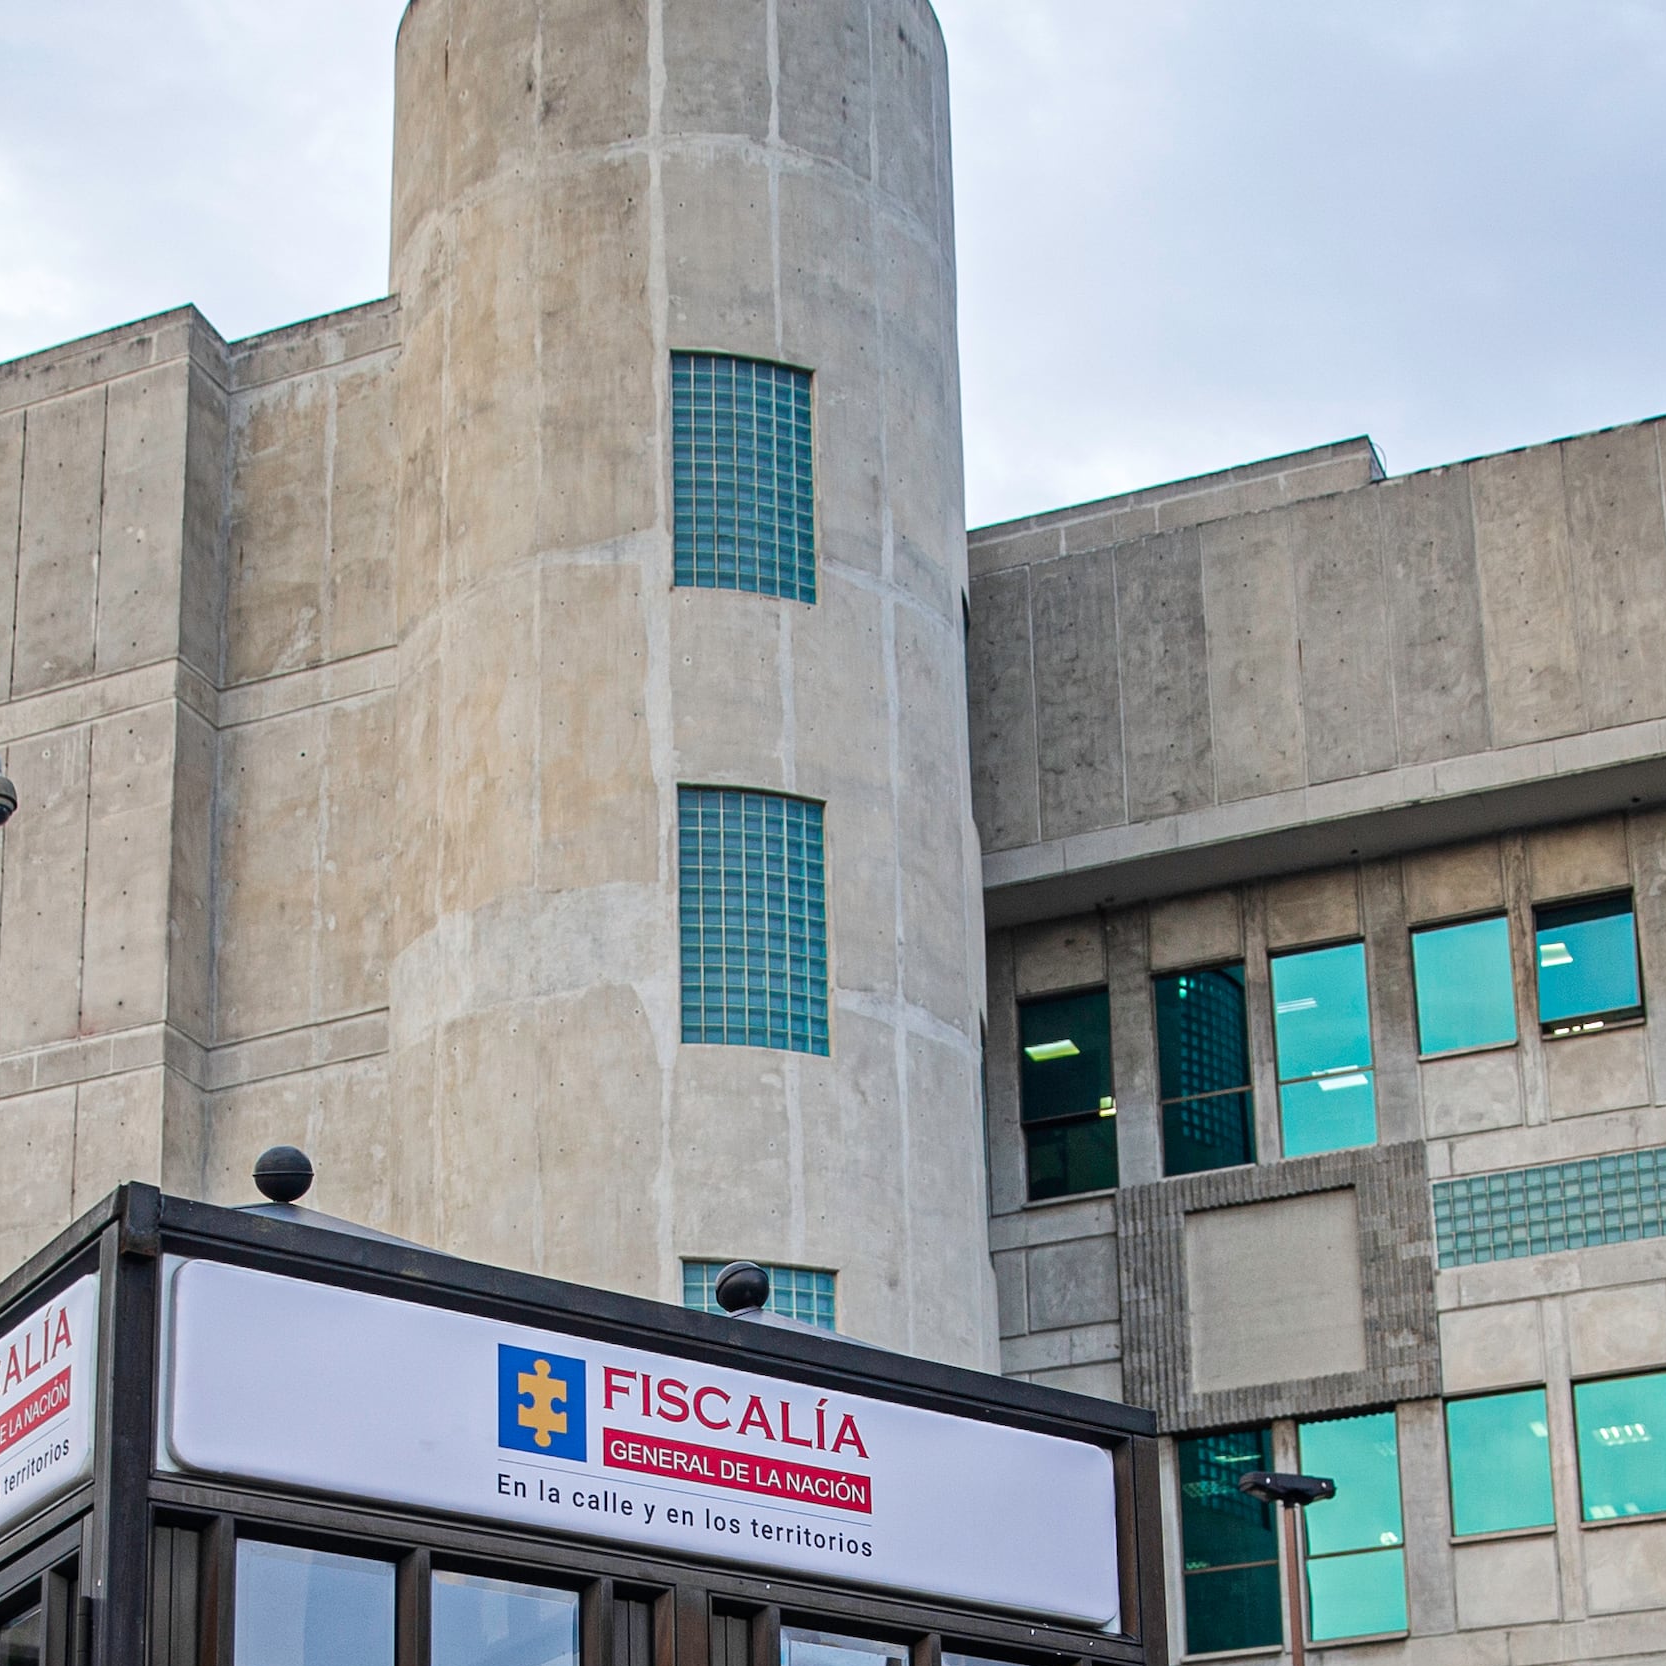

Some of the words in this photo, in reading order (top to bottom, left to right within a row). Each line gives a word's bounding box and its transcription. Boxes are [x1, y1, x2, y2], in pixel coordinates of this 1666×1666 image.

[9, 1416, 24, 1439] LA
[24, 1379, 68, 1431] NACIÓN
[602, 1365, 871, 1459] FISCALÍA
[4, 1438, 70, 1495] territorios
[610, 1439, 715, 1478] GENERAL
[720, 1459, 750, 1484] DE
[755, 1466, 782, 1490] LA
[786, 1475, 866, 1505] NACIÓN
[497, 1472, 527, 1498] En
[539, 1479, 561, 1504] la
[572, 1489, 634, 1516] calle
[643, 1503, 656, 1524] y
[666, 1507, 694, 1527] en
[706, 1508, 741, 1534] los
[750, 1518, 873, 1557] territorios
